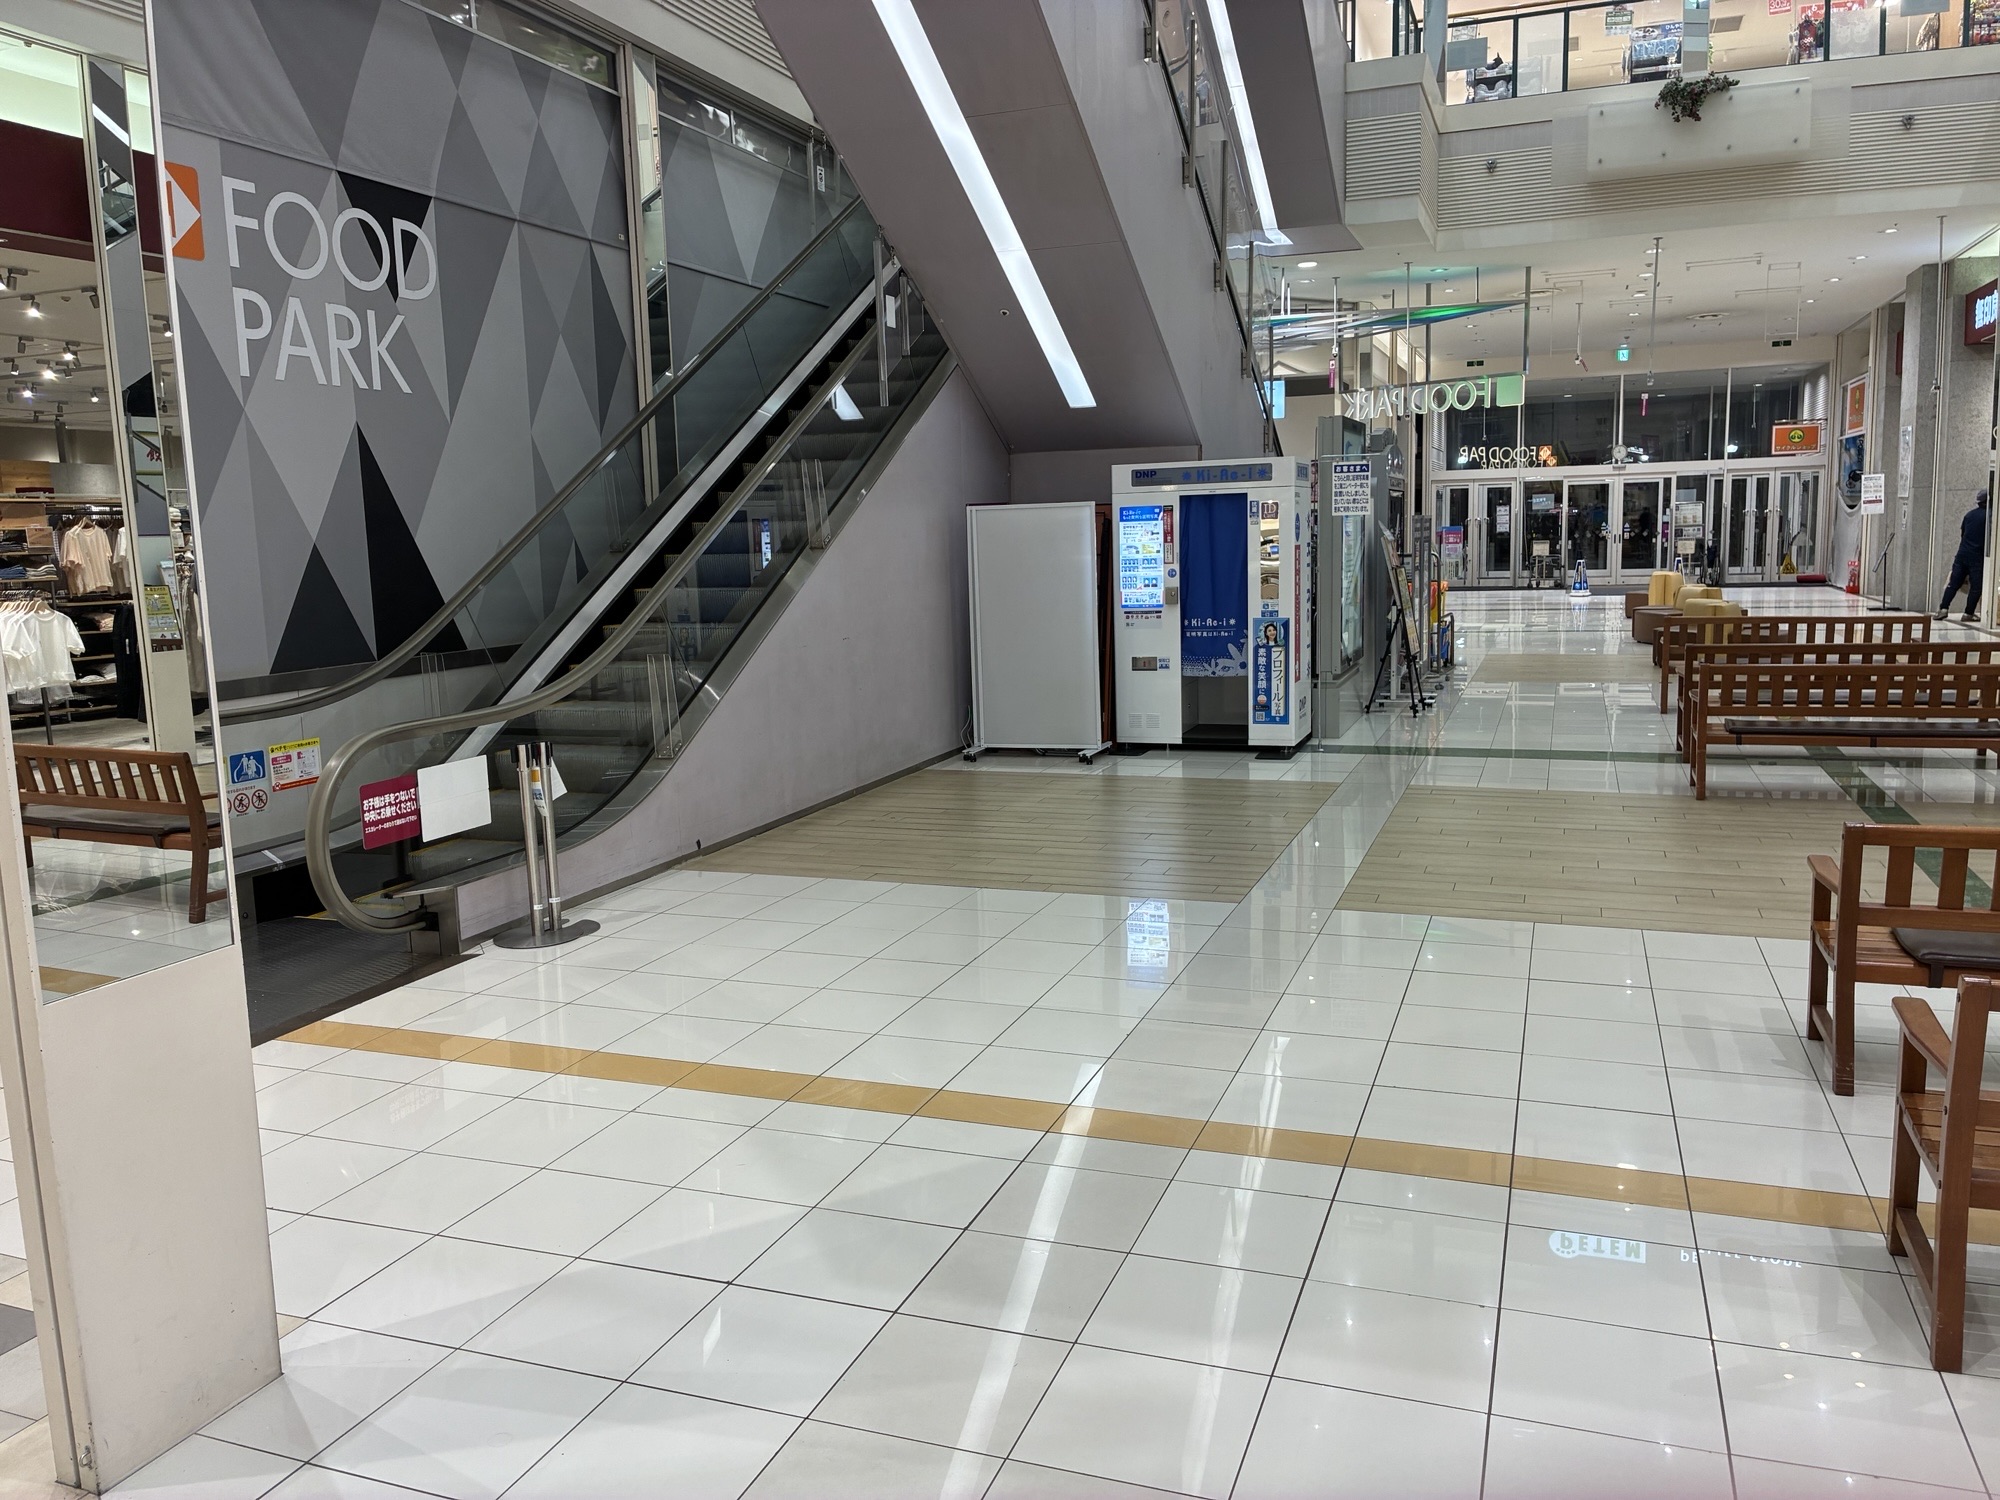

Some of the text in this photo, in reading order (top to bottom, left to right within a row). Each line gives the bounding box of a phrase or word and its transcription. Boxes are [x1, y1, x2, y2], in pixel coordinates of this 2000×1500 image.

[221, 176, 438, 301] FOOD
[232, 288, 413, 394] PARK
[1135, 470, 1157, 478] DNP
[1196, 467, 1252, 481] Ki-Re-i
[1335, 465, 1368, 473] お客さまへ
[1263, 503, 1276, 513] ID
[1191, 618, 1226, 627] Ki-Re-i
[363, 788, 416, 811] お子様は手をつないで
[364, 801, 417, 823] 中央にお乗せください
